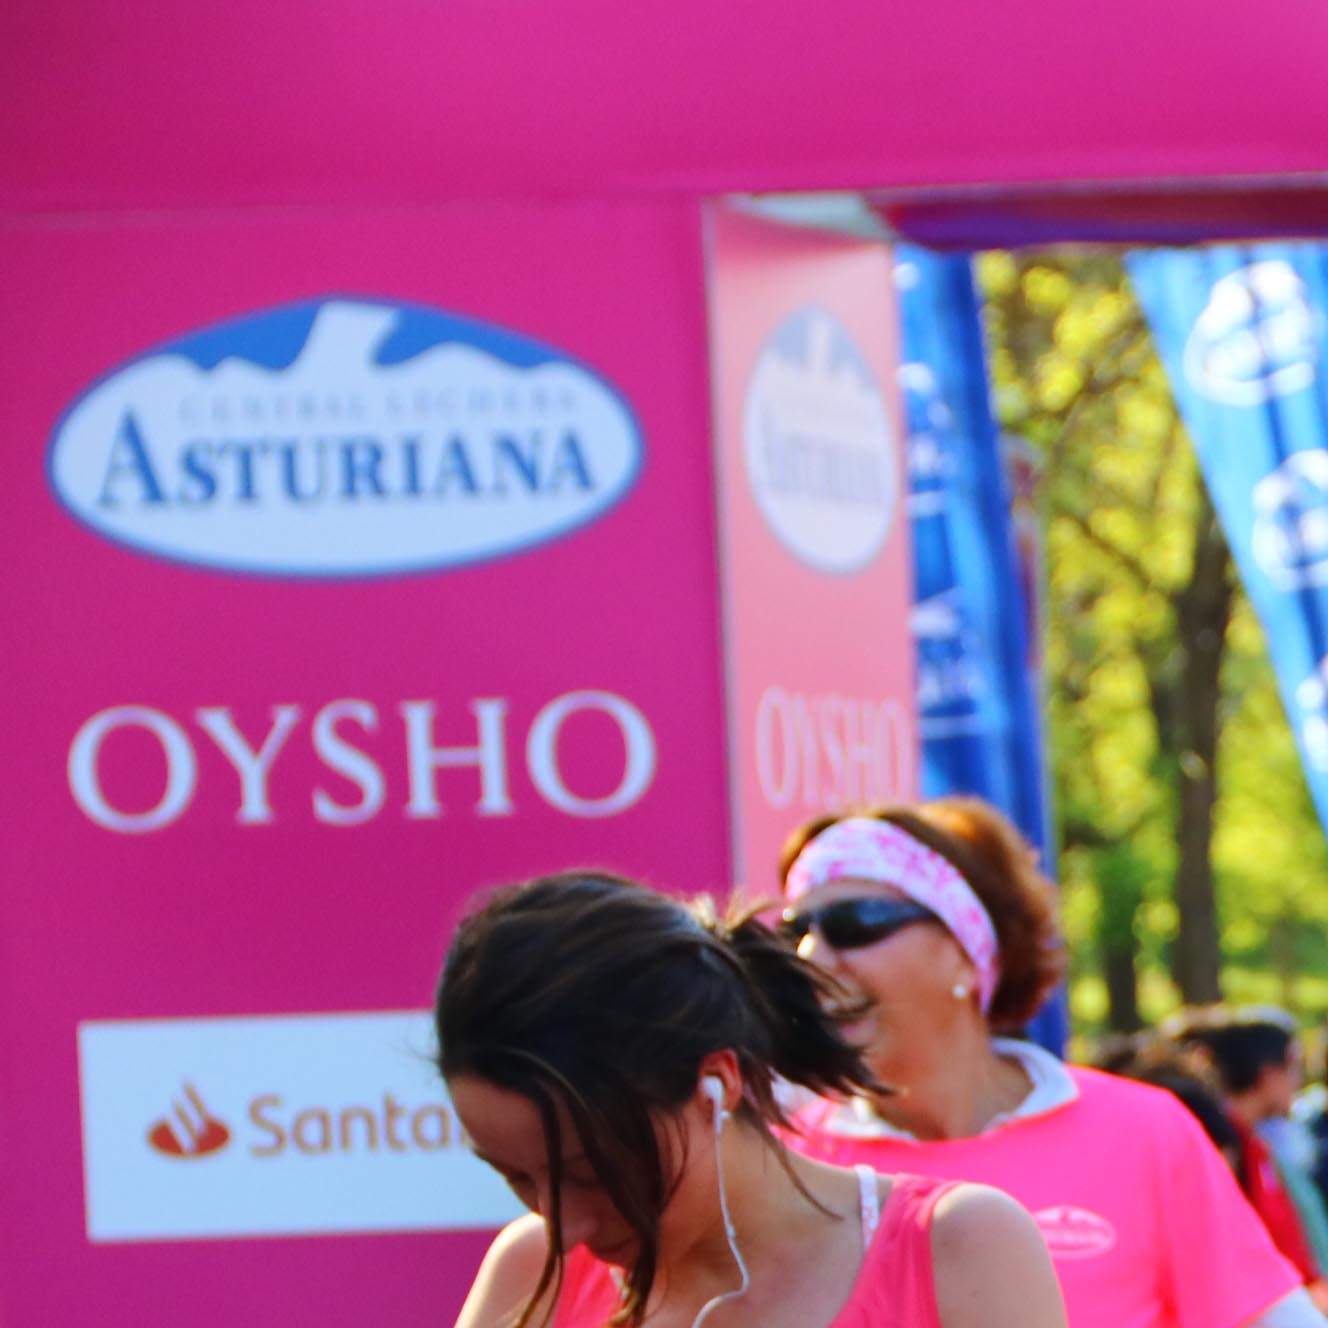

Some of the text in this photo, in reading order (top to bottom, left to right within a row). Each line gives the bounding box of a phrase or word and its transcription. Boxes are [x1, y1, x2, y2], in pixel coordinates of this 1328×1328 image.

[98, 406, 595, 509] ASTURIANA
[67, 690, 656, 834] OYSHO
[756, 686, 913, 809] OYSHO
[249, 1091, 474, 1158] Santa
